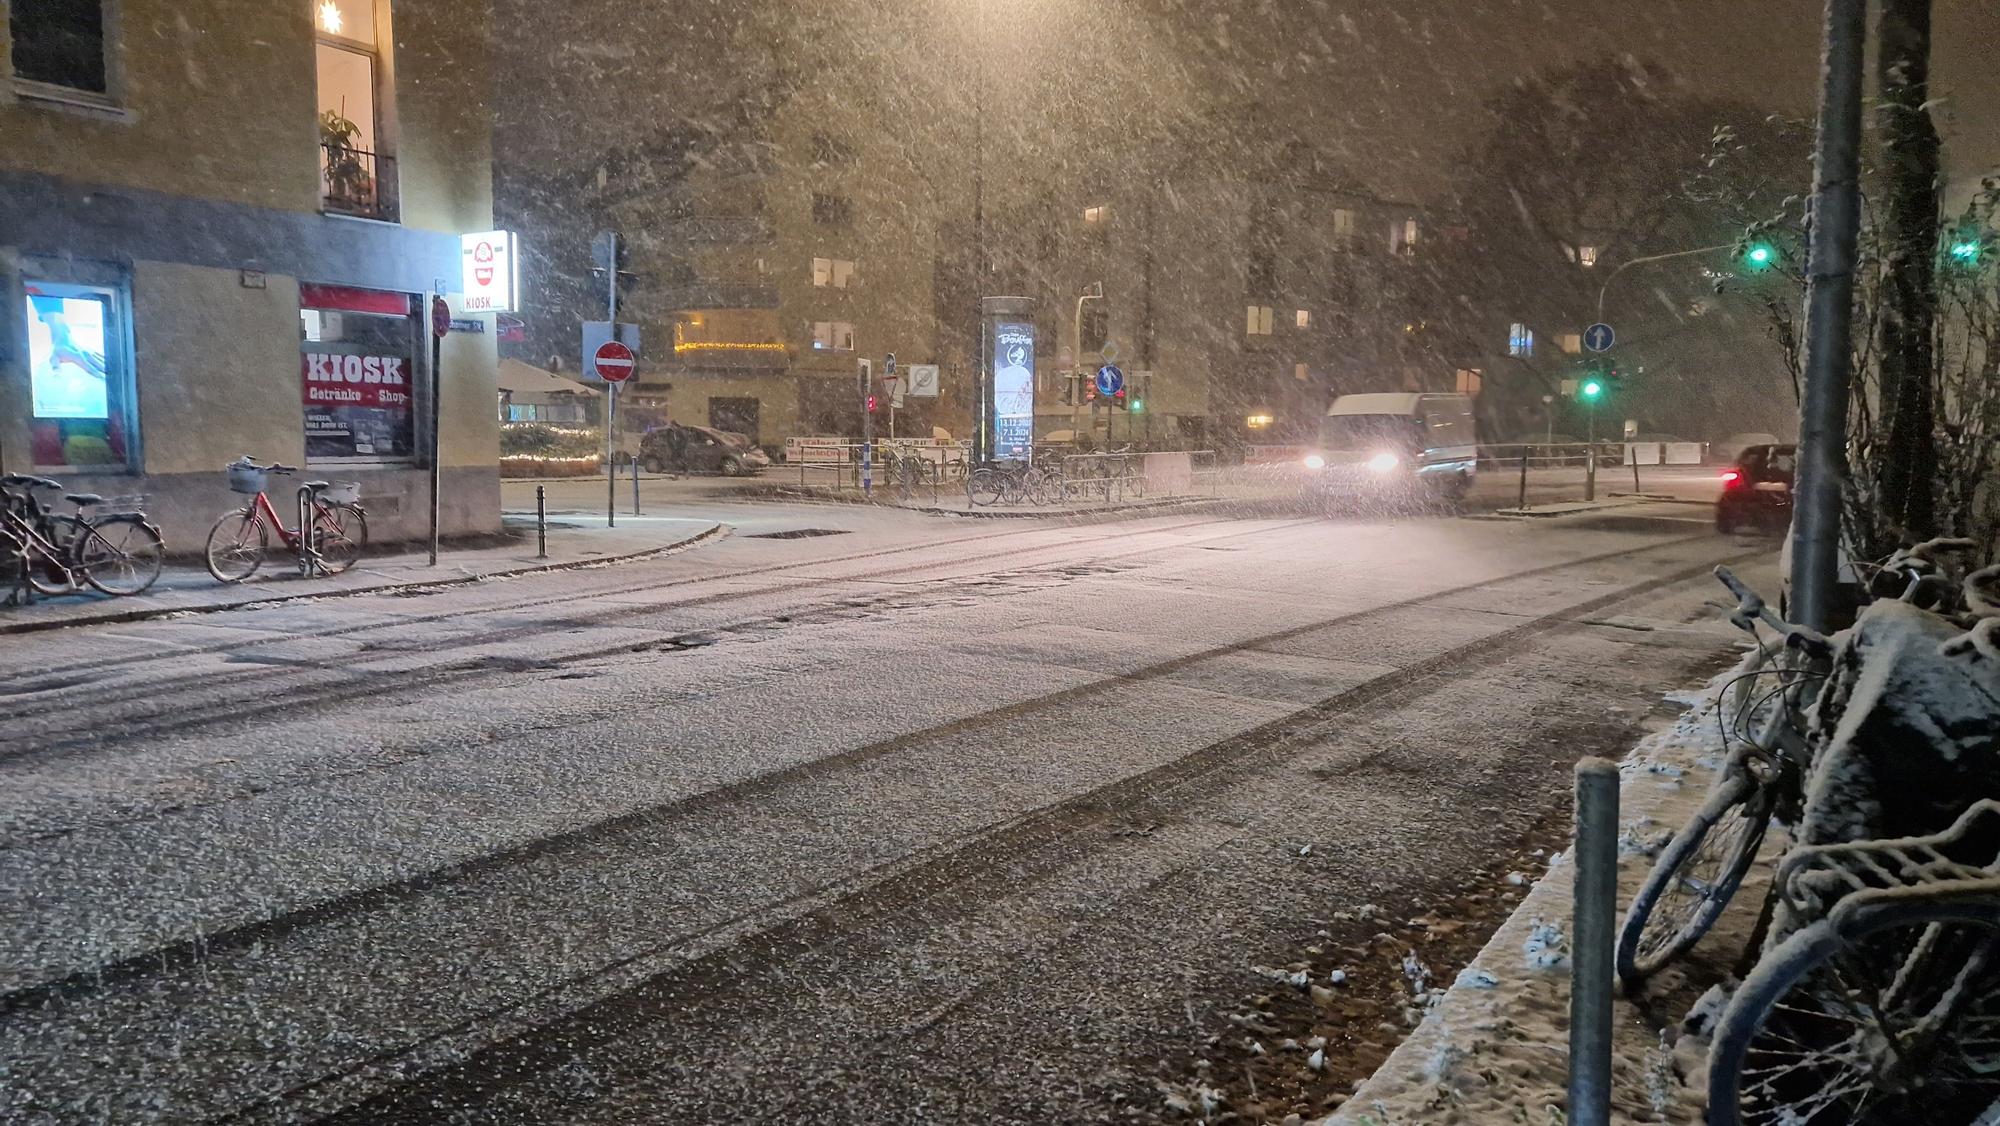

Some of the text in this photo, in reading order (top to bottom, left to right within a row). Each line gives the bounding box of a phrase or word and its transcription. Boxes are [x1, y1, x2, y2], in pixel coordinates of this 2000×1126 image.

[466, 297, 491, 309] KIOSK
[306, 353, 403, 385] KIOSK
[310, 387, 361, 401] Getränke
[379, 390, 406, 404] Shop
